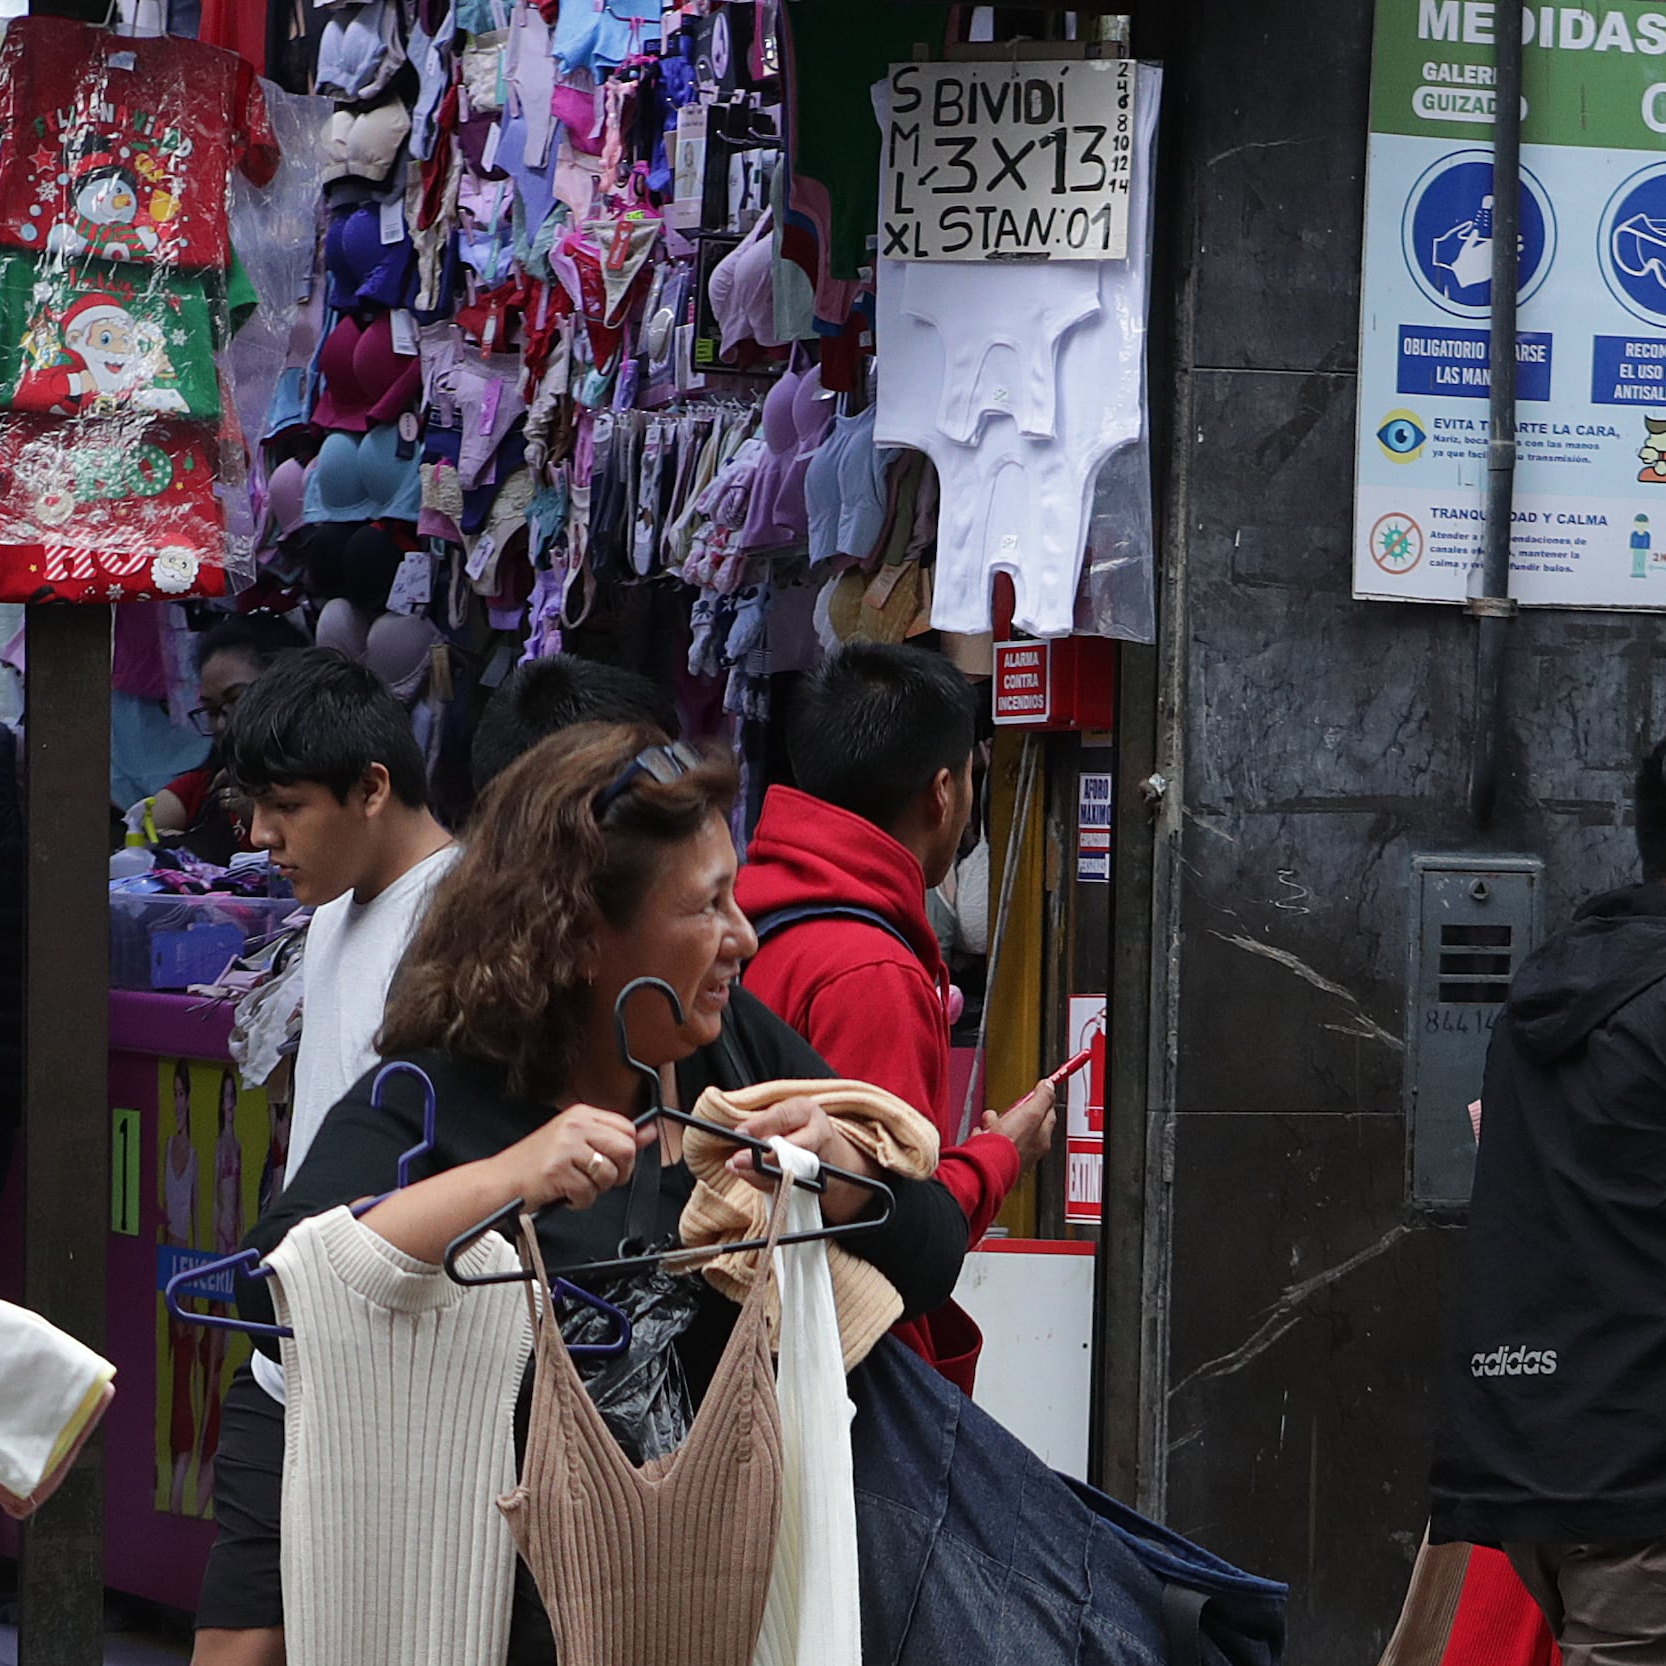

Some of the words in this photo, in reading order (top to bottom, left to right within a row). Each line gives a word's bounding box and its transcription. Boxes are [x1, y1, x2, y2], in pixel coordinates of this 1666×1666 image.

[1118, 62, 1129, 78] 2
[892, 66, 922, 114] S
[1117, 80, 1128, 94] 4
[1117, 94, 1129, 110] 6
[889, 121, 920, 168] M
[1117, 114, 1129, 132] 8
[1112, 135, 1130, 151] 10
[1111, 155, 1128, 172] 12
[895, 171, 914, 214] L
[1108, 178, 1129, 195] 14
[883, 221, 929, 258] XL
[1403, 337, 1485, 360] OBLIGATORIO
[1436, 365, 1460, 385] LAS
[1462, 366, 1492, 386] MAN
[1619, 364, 1635, 380] EL
[1637, 365, 1663, 381] USO
[1433, 418, 1475, 430] EVITA
[1552, 424, 1571, 435] LA
[1575, 425, 1621, 438] CARA,
[1433, 434, 1462, 444] Nariz,
[1464, 436, 1489, 445] boca
[1546, 440, 1562, 449] las
[1565, 442, 1600, 450] manos
[1542, 513, 1552, 524] Y
[1556, 514, 1608, 526] CALMA
[1429, 531, 1469, 540] Atender
[1471, 533, 1478, 541] a
[1574, 537, 1587, 545] de
[1429, 545, 1468, 554] canales
[1518, 550, 1568, 560] mantener
[1570, 551, 1580, 560] la
[1429, 560, 1459, 568] calma
[1462, 562, 1468, 570] y
[1003, 651, 1039, 668] ALARMA
[1003, 673, 1039, 690] CONTRA
[998, 694, 1044, 711] INCENDIOS
[1084, 778, 1109, 800] AFORO
[119, 1117, 128, 1231] 1
[1470, 1344, 1558, 1377] adidas
